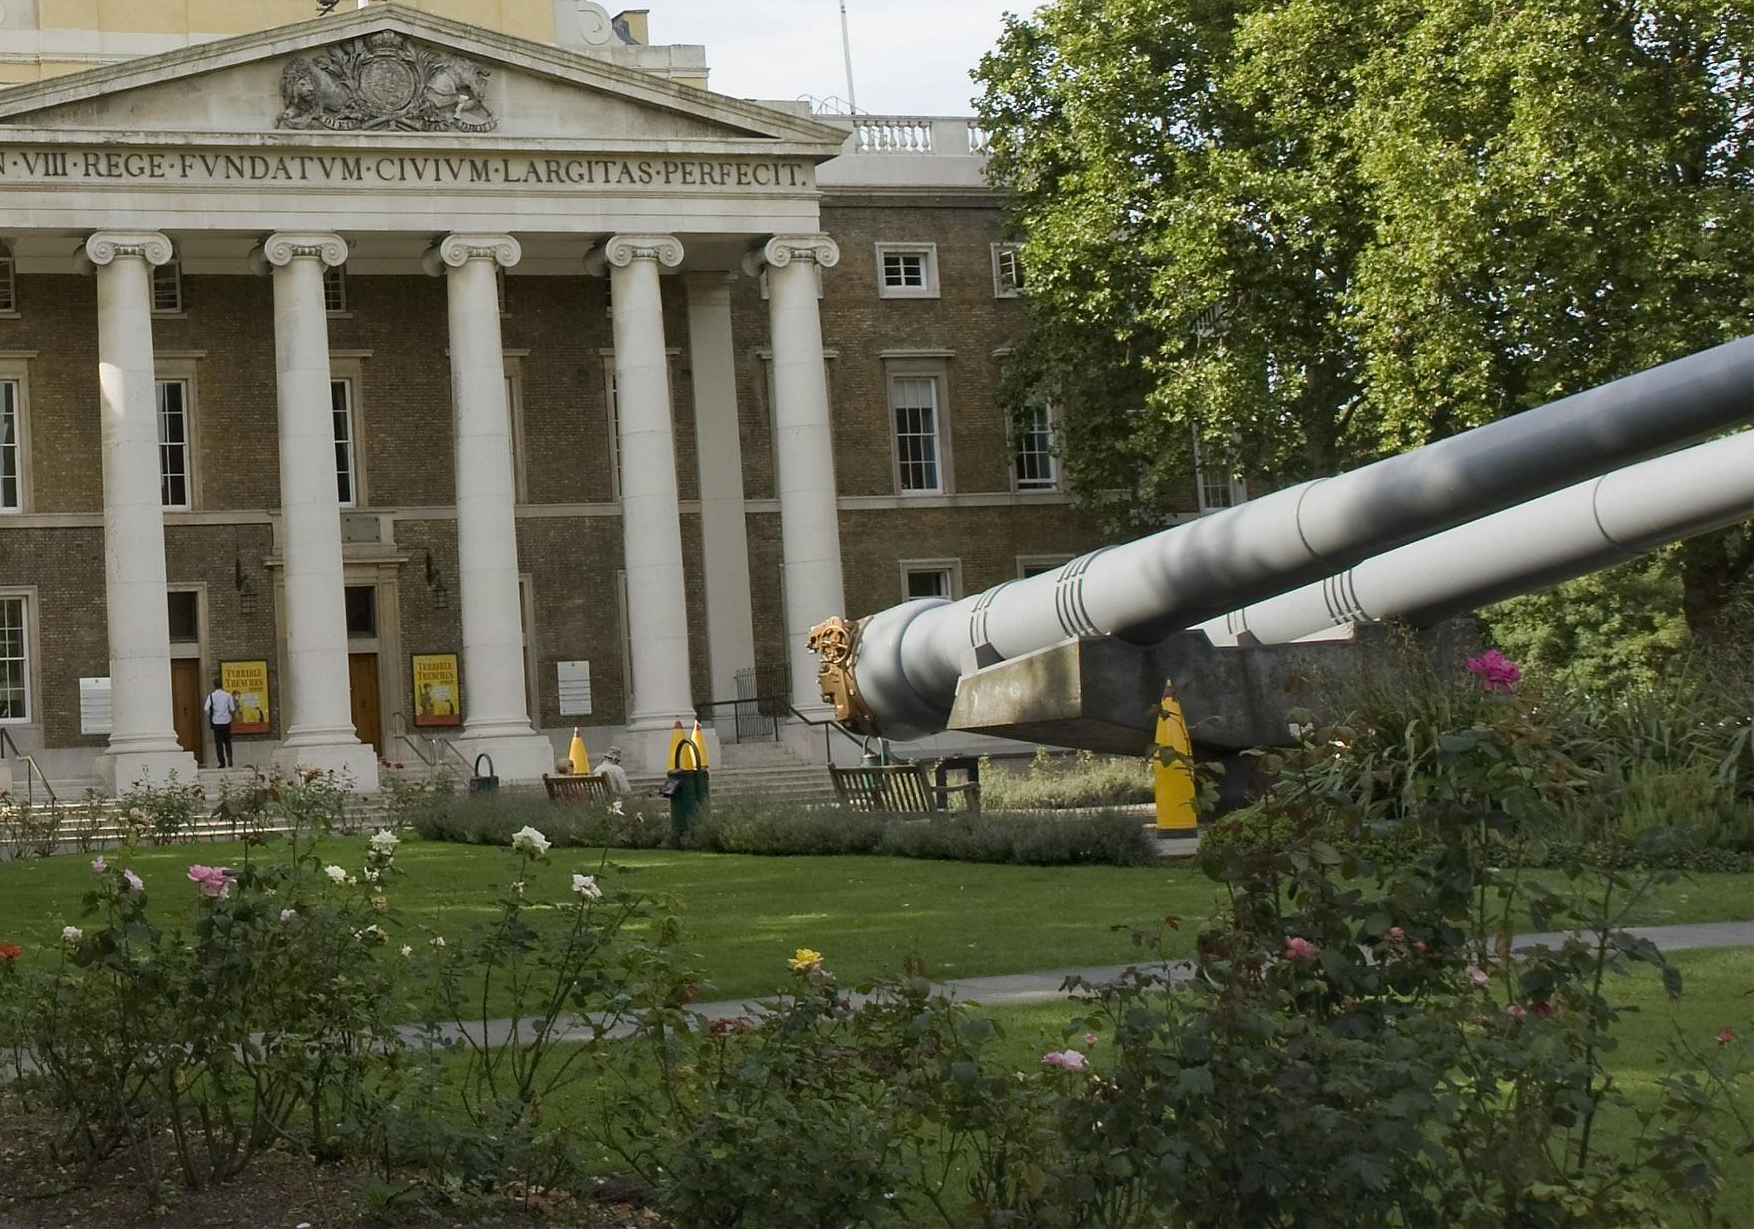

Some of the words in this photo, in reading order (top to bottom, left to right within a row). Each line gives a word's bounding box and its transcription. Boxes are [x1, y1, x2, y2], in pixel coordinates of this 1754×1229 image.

[20, 151, 68, 177] VIII
[82, 152, 166, 178] REGE
[179, 153, 363, 181] FVNDATVM
[375, 156, 491, 182] CIVIVM
[502, 158, 654, 184] LARGITAS
[663, 160, 807, 186] PERFECIT.
